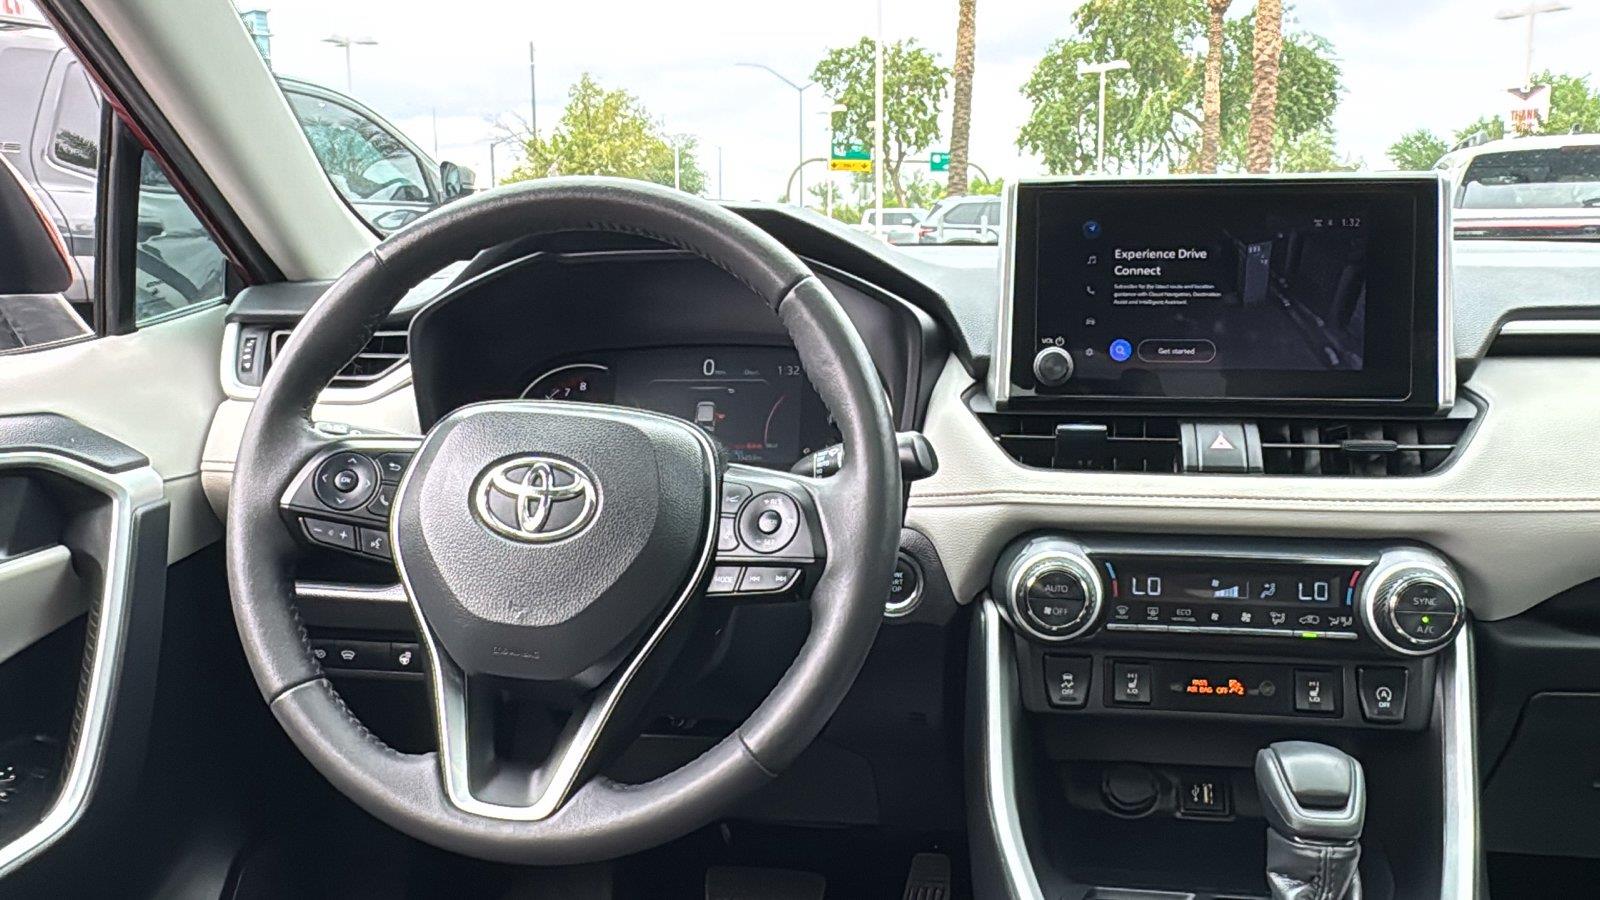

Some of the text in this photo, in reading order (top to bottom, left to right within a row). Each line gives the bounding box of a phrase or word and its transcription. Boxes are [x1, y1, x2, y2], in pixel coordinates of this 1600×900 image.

[1114, 248, 1208, 261] Experience Drive
[1114, 265, 1162, 276] Connect
[1158, 347, 1196, 355] Get started
[702, 358, 716, 376] 0
[579, 381, 588, 391] 8
[564, 387, 572, 397] 7
[1044, 583, 1069, 594] AUTO
[1132, 576, 1162, 596] LO
[1298, 582, 1329, 601] LO
[1412, 596, 1438, 607] SYNC
[1052, 606, 1069, 616] OFF
[1176, 608, 1193, 616] ECO
[1416, 624, 1435, 635] A/C
